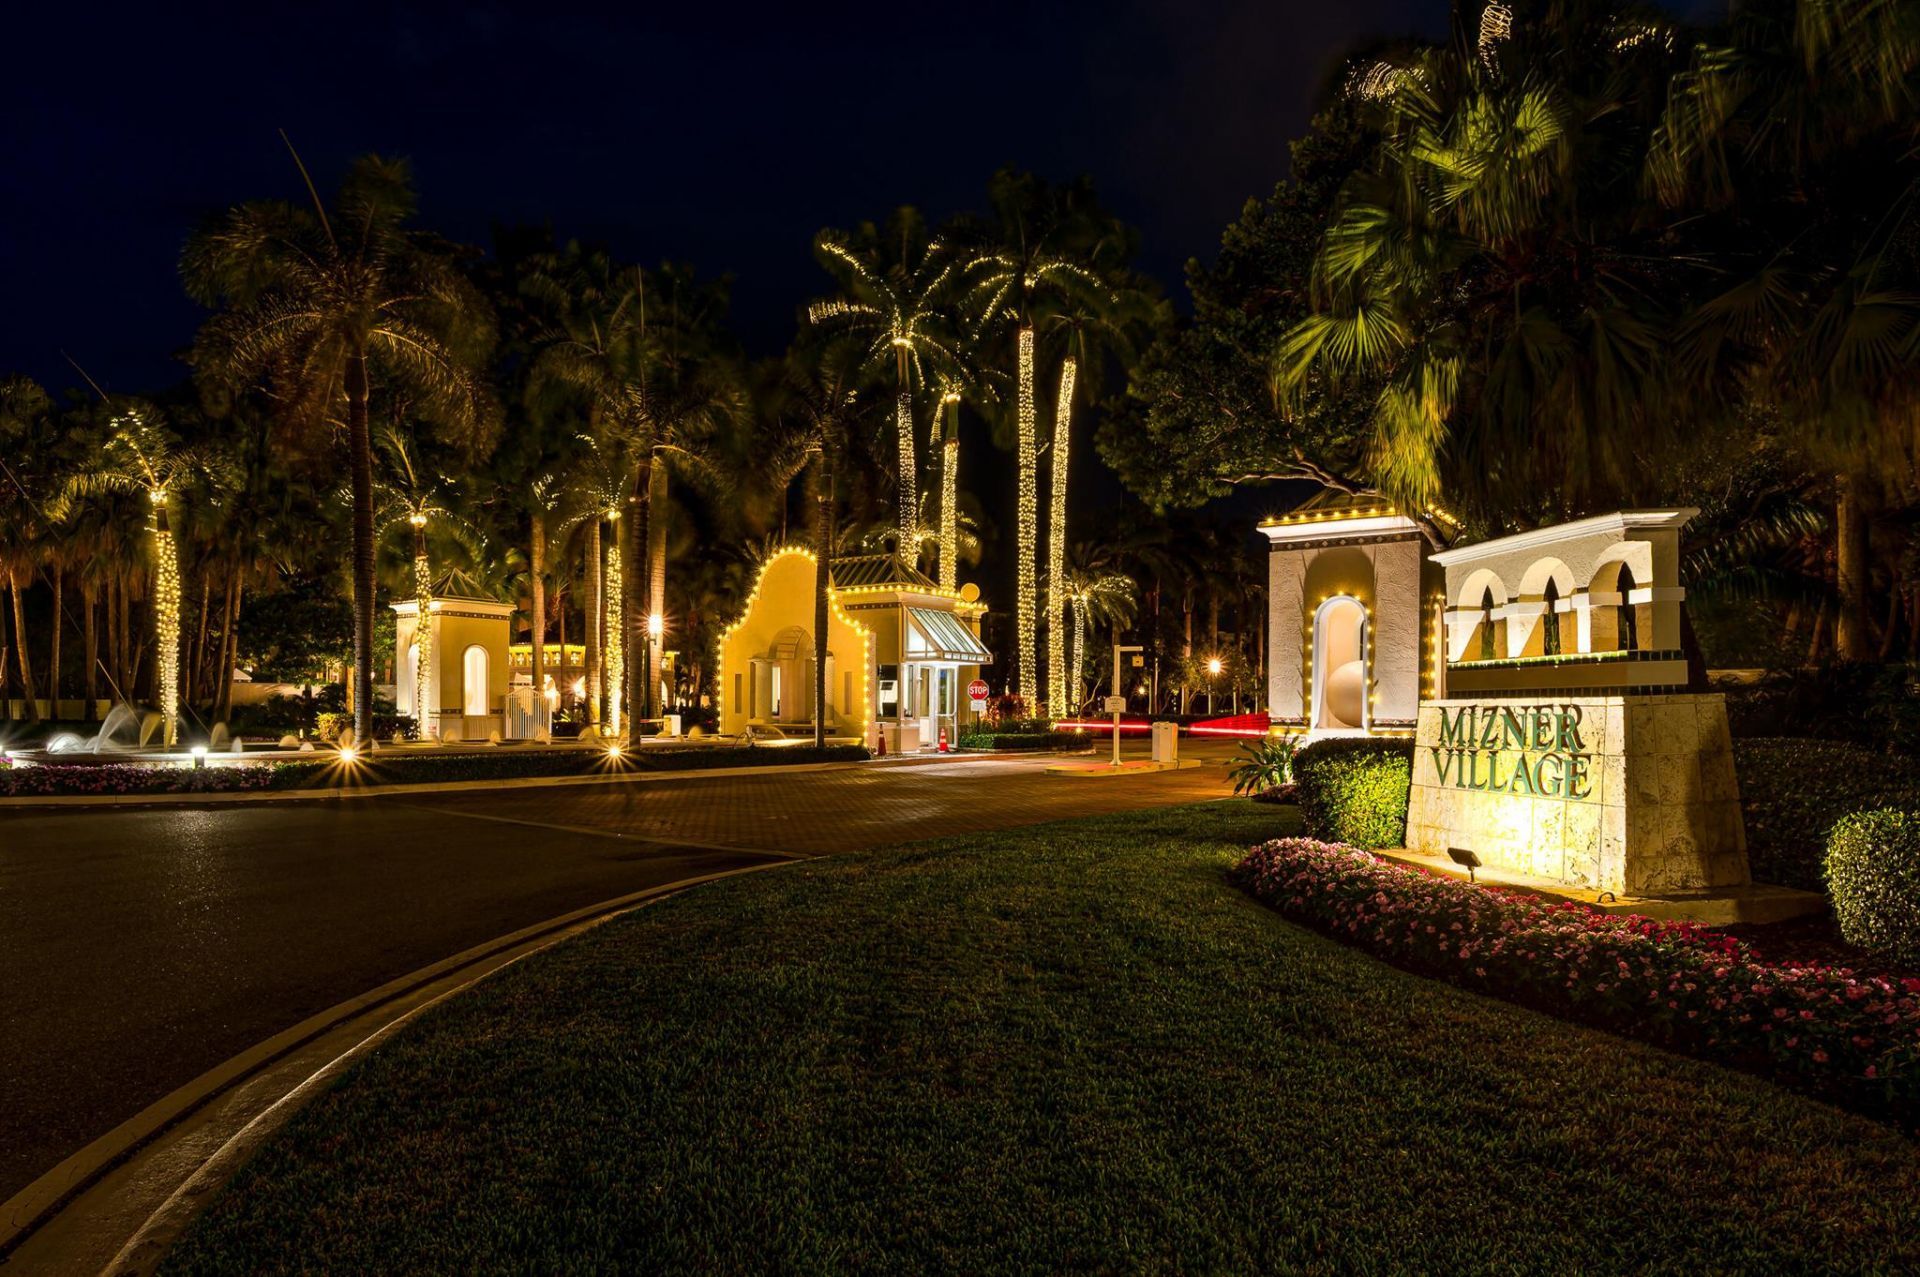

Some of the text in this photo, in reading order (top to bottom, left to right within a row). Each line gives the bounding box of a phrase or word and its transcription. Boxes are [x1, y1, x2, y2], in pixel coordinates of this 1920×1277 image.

[969, 685, 988, 695] STOP
[1438, 707, 1584, 753] MIZNER
[1431, 749, 1588, 800] VILLAGE
